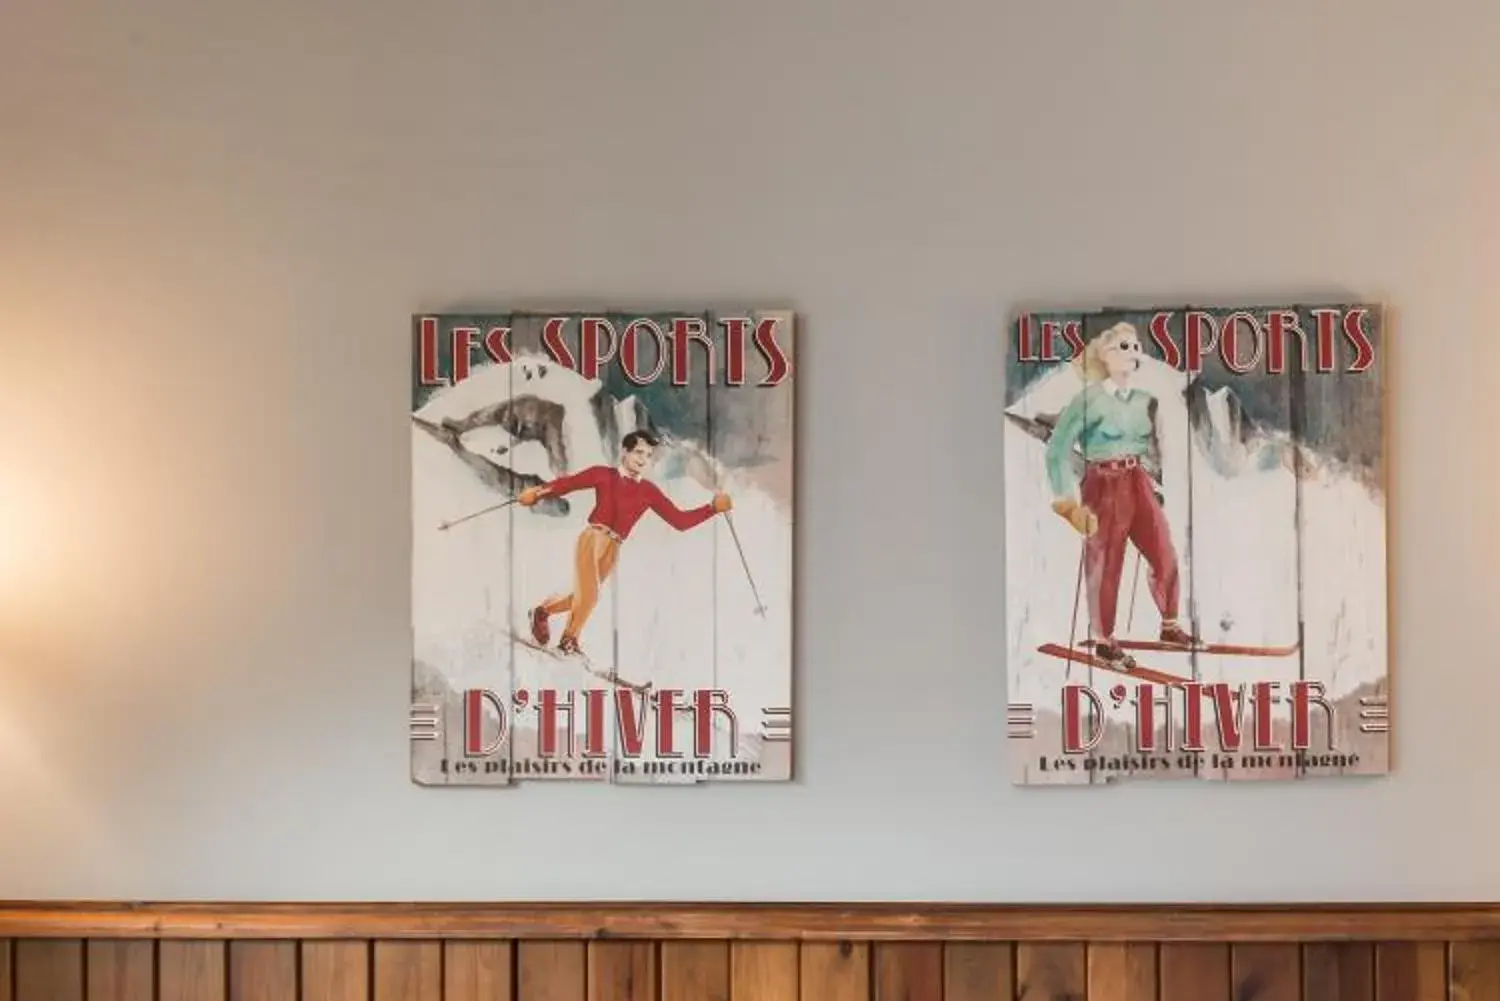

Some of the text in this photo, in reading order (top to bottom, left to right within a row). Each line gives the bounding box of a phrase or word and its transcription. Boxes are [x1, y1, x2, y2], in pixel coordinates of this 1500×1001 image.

[543, 317, 791, 386] SPORTS
[1018, 308, 1375, 374] LES SPORTS
[463, 688, 740, 759] D'HIVER
[1062, 682, 1338, 754] D'HIVER
[578, 759, 607, 774] de
[614, 759, 635, 775] la
[1039, 755, 1076, 771] Les
[1212, 753, 1233, 769] la
